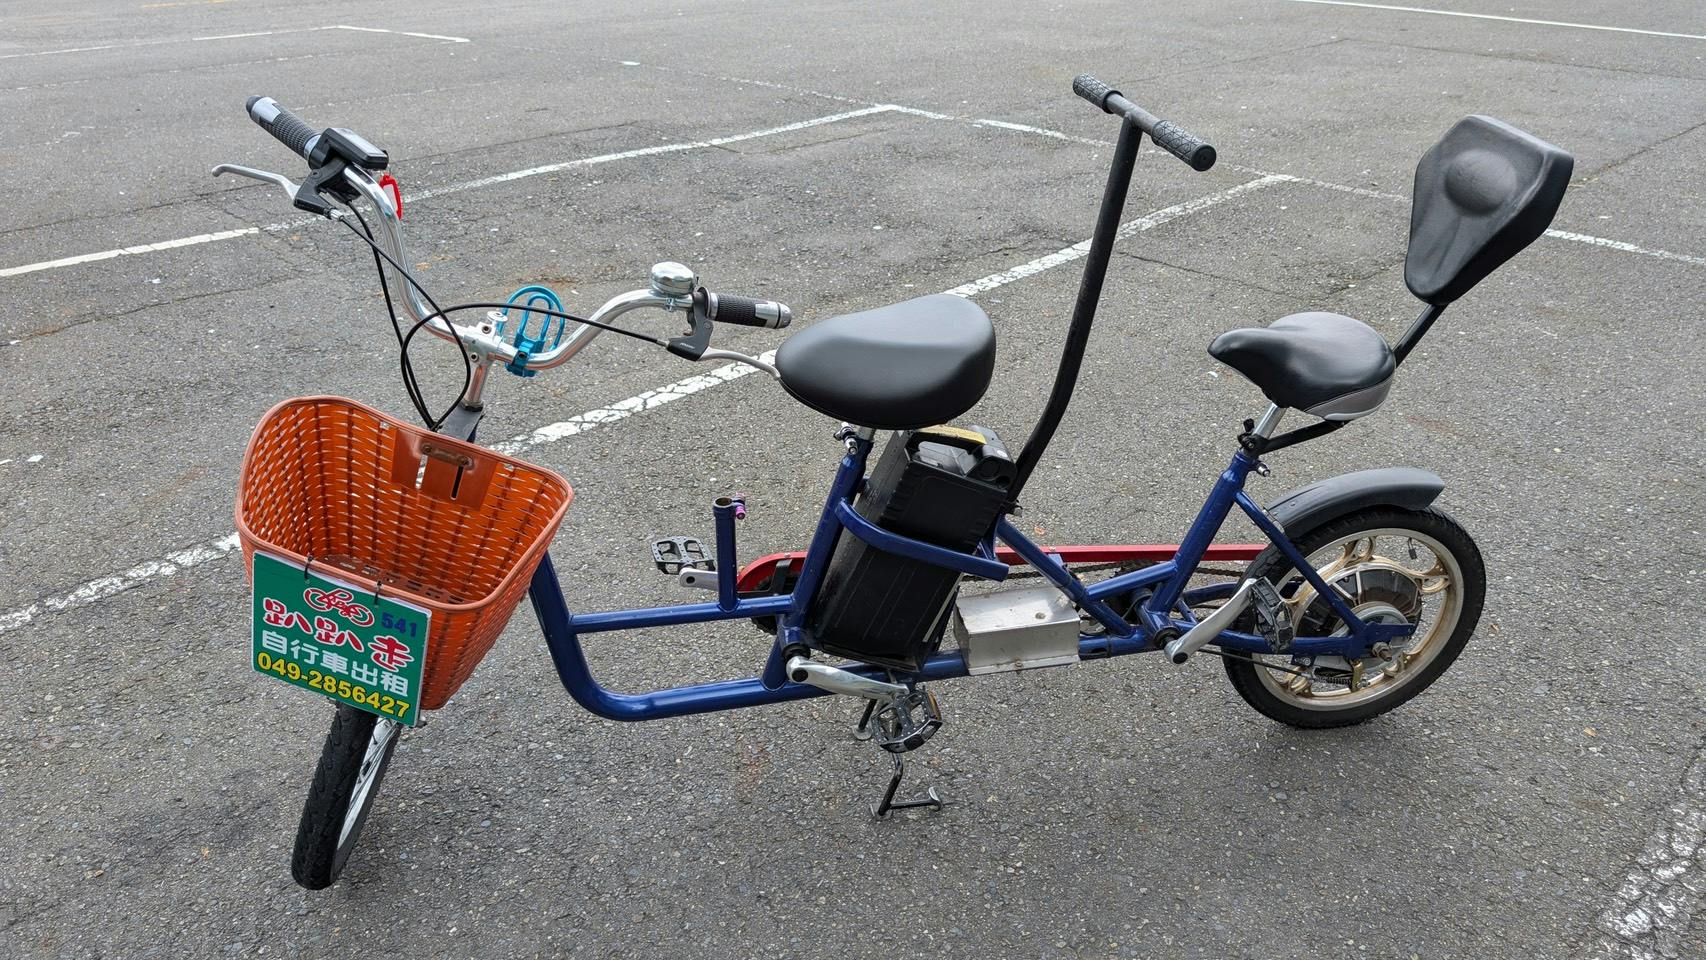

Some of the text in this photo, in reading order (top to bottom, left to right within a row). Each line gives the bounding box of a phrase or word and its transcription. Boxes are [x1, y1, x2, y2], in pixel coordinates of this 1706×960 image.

[263, 597, 414, 672] 趴趴走
[381, 612, 417, 638] 541
[257, 652, 410, 718] 049-2856427
[262, 629, 409, 697] 自行車出租
